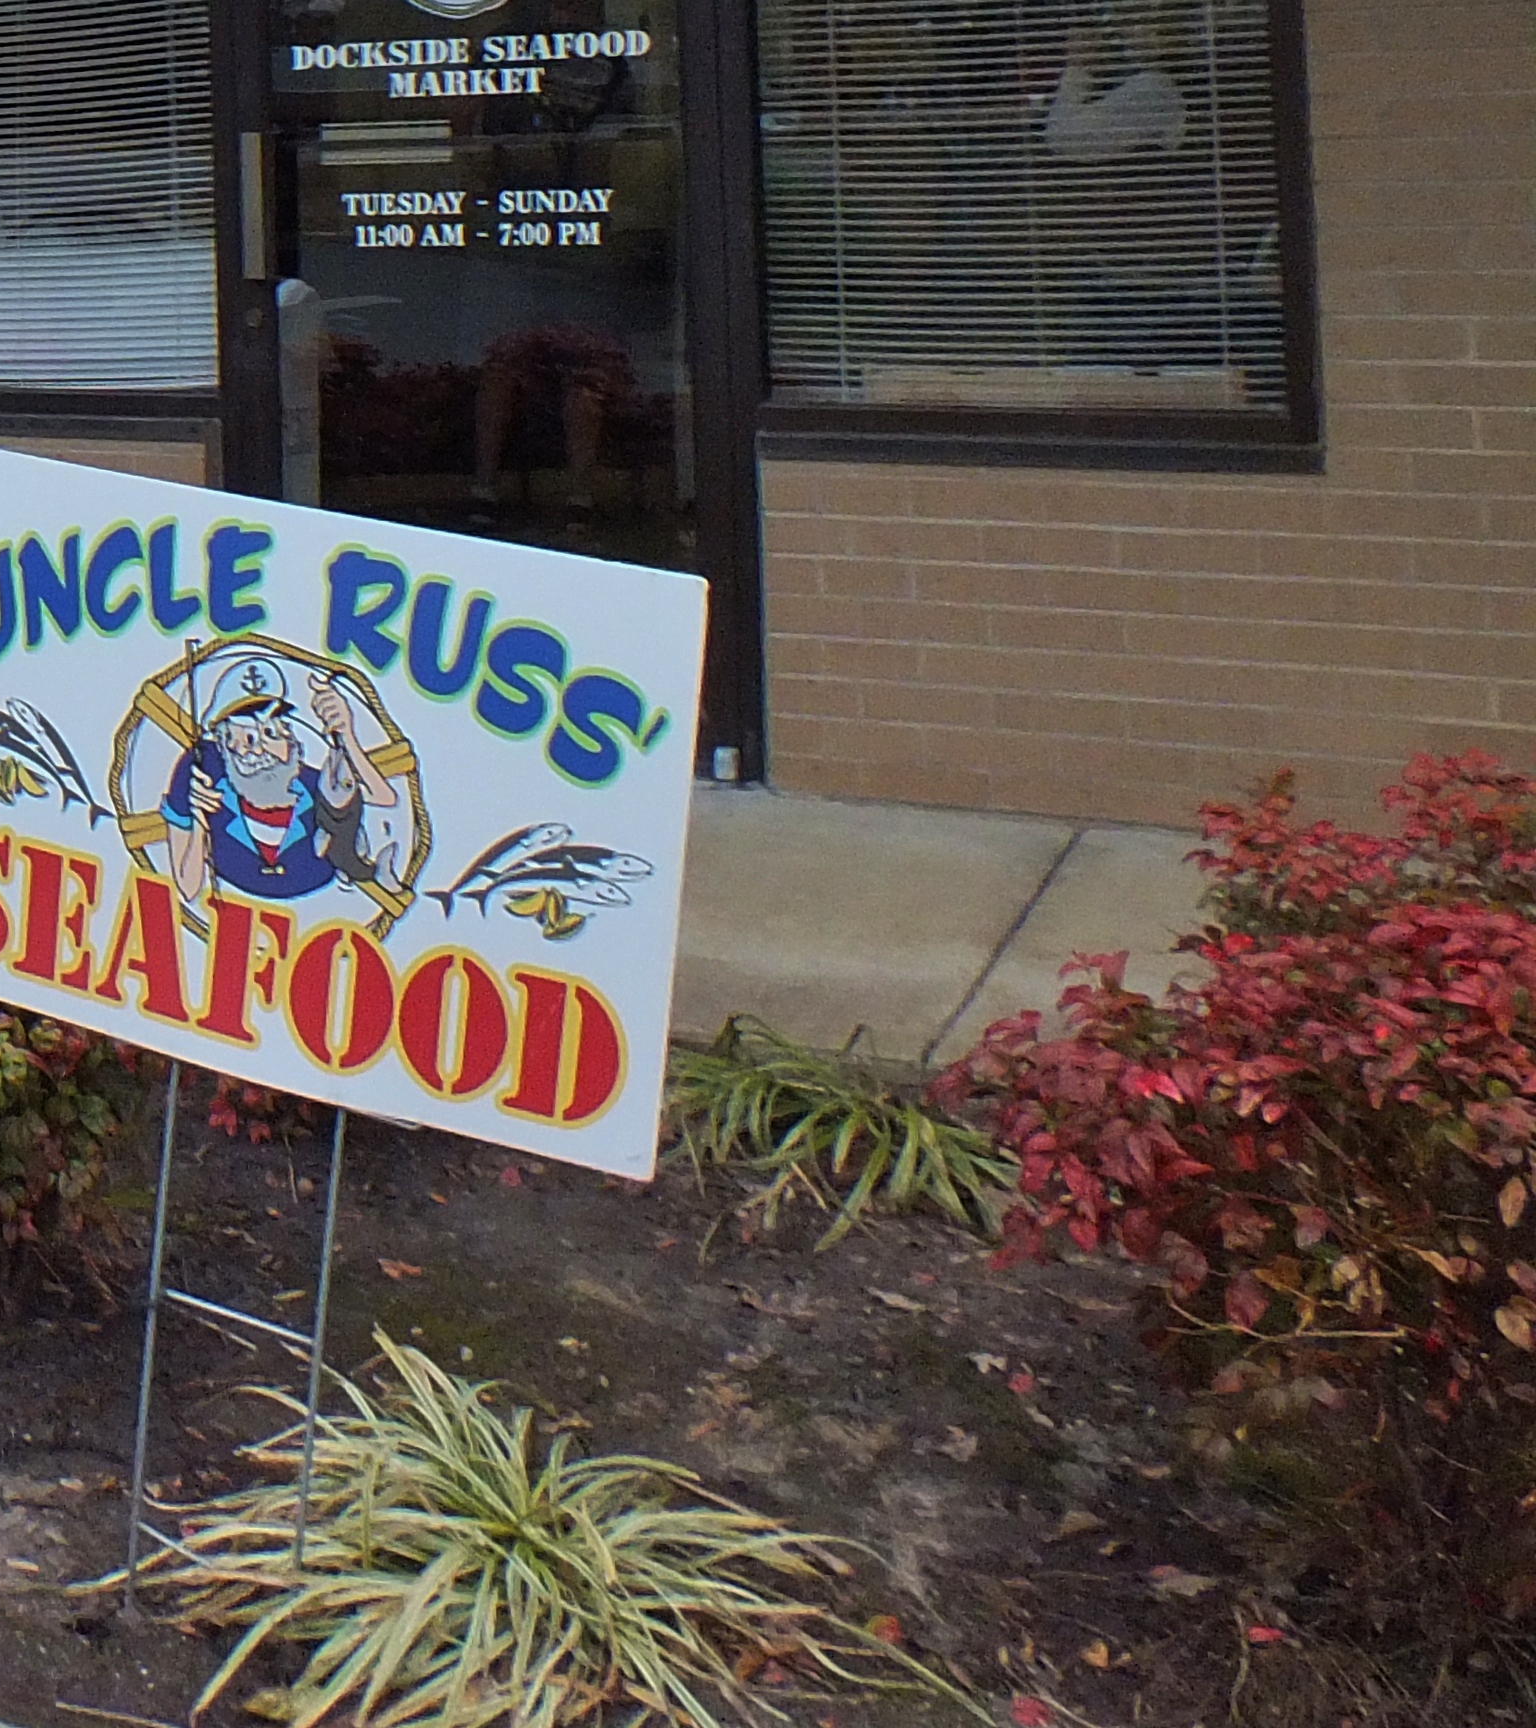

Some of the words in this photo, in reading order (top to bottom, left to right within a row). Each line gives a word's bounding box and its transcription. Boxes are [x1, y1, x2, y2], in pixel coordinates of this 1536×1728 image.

[291, 37, 470, 72] DOCKSIDE
[483, 29, 652, 63] SEAFOOD
[389, 67, 546, 99] MARKET
[341, 190, 467, 217] TUESDAY
[498, 188, 614, 215] SUNDAY
[355, 223, 415, 249] 11:00
[419, 222, 466, 248] AM
[498, 221, 552, 247] 7:00
[557, 221, 603, 247] PM
[326, 544, 670, 789] RUSS'
